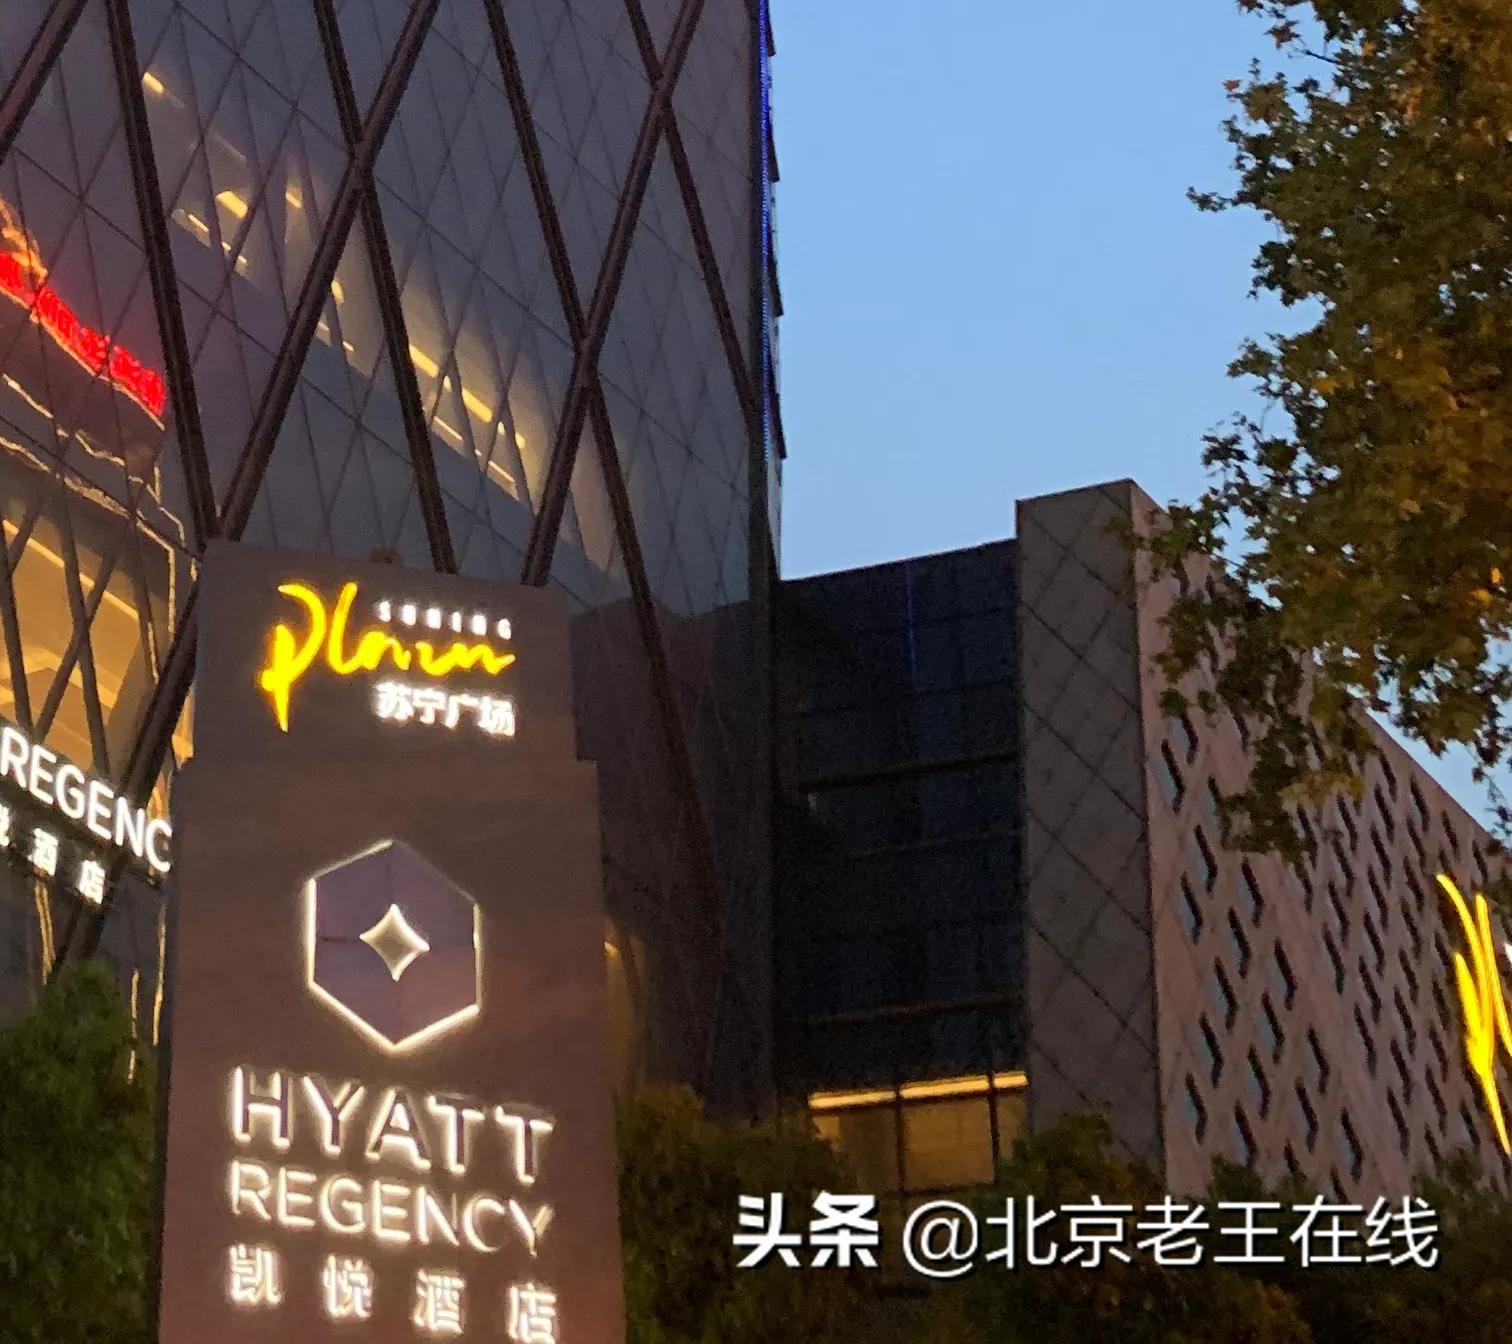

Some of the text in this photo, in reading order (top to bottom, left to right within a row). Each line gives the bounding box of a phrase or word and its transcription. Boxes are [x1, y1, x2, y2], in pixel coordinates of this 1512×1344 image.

[374, 679, 516, 737] 苏宁广场
[0, 726, 173, 873] REGENC
[229, 1064, 556, 1186] HYATT
[228, 1159, 555, 1257] REGENCY
[228, 1242, 558, 1344] 凯悦酒店
